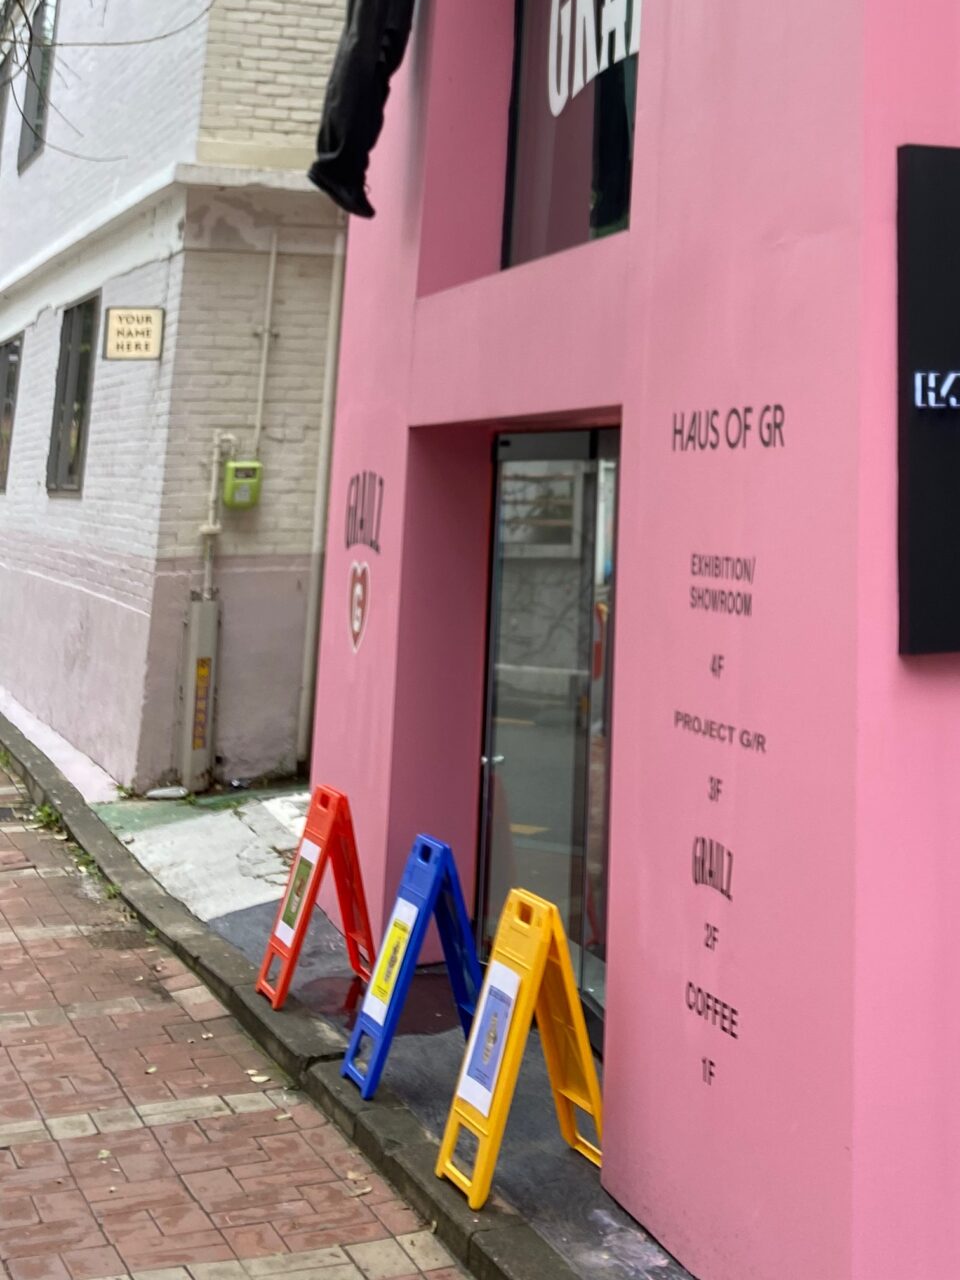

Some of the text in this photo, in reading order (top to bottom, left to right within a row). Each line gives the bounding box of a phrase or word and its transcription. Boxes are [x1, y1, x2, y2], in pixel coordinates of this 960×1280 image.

[117, 328, 152, 338] NAME
[118, 314, 153, 325] YOUR
[116, 342, 151, 352] HERE
[672, 403, 785, 451] HAUS OF GR
[691, 553, 756, 585] EXHIBITION/
[690, 585, 752, 616] SHOWROOM
[710, 654, 725, 679] 4F
[674, 710, 767, 754] PROJECT G/R
[708, 776, 723, 802] 3F
[692, 836, 733, 901] GRAILZ
[704, 923, 719, 950] 2F
[685, 981, 738, 1040] COFFEE
[701, 1056, 716, 1086] 1F
